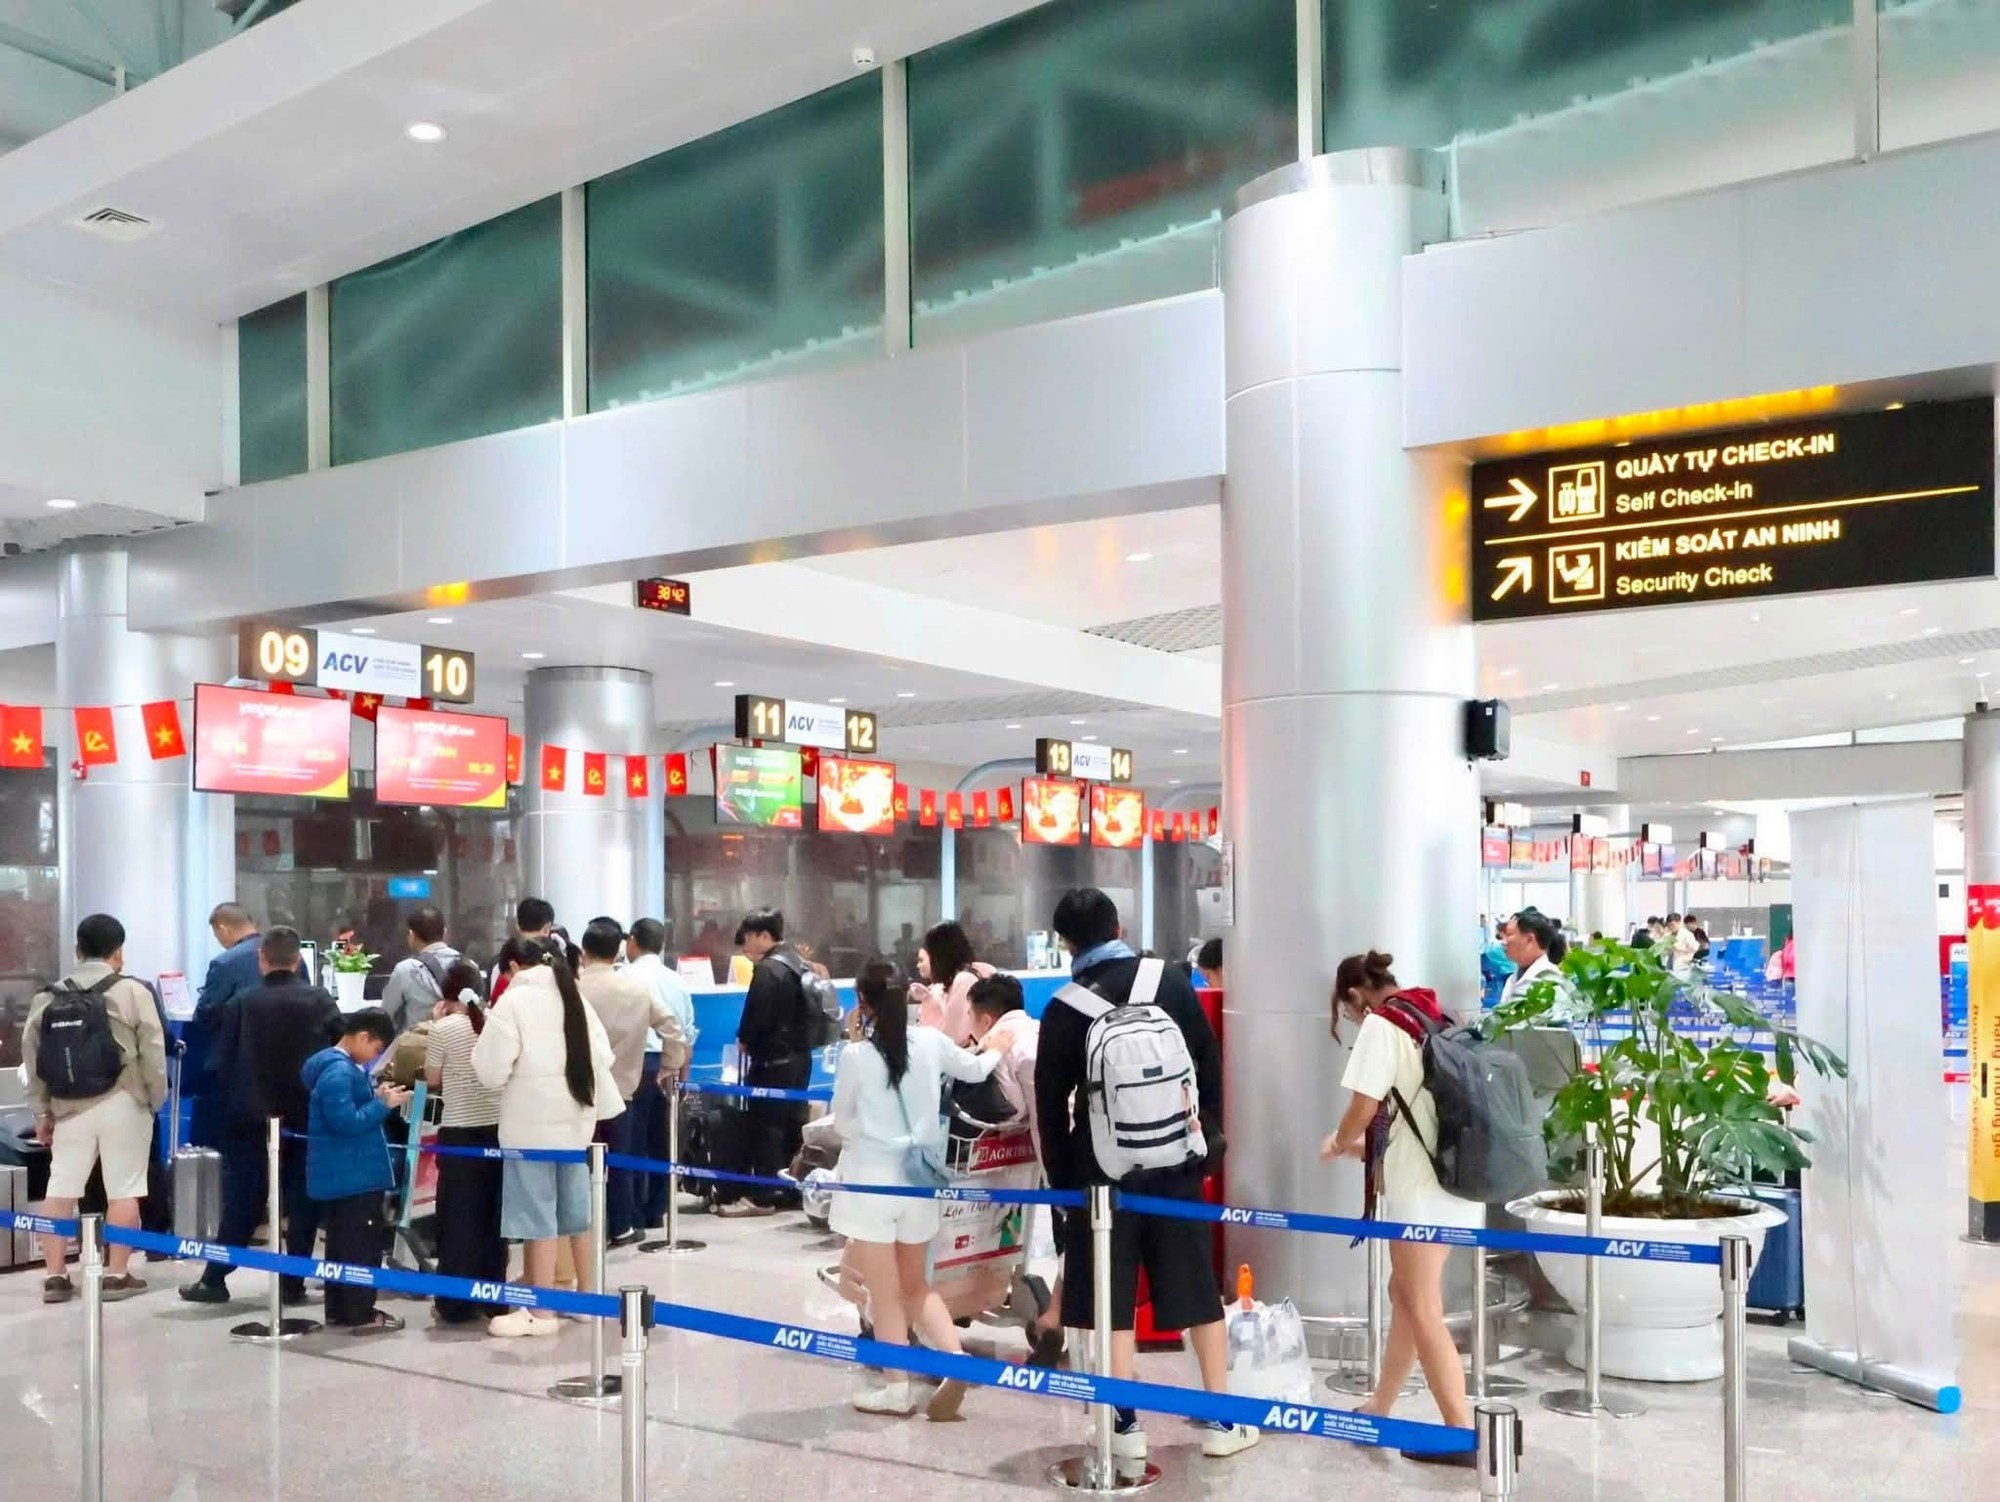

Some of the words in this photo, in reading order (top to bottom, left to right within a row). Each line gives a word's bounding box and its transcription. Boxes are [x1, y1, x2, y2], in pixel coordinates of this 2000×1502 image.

[1722, 433, 1835, 465] CHECK-IN
[1615, 491, 1655, 514] Self
[1660, 481, 1753, 508] Check-in
[1675, 528, 1738, 555] SOÁT
[1742, 525, 1776, 548] AN
[1783, 519, 1840, 544] NINH
[1616, 571, 1699, 595] Security
[1704, 563, 1773, 587] Check
[260, 631, 309, 677] 09
[323, 652, 368, 674] ACV
[426, 654, 468, 697] 10
[753, 701, 781, 736] 11
[788, 715, 815, 731] ACV
[848, 714, 874, 748] 12
[1049, 743, 1069, 770] 13
[1112, 752, 1131, 780] 14
[14, 1214, 33, 1231] ACV
[1220, 1207, 1253, 1224] ACV
[1402, 1226, 1437, 1242] ACV
[178, 1239, 204, 1258] ACV
[1605, 1240, 1647, 1257] ACV
[315, 1261, 343, 1279] ACV
[470, 1282, 502, 1301] ACV
[772, 1327, 814, 1351] ACV
[997, 1365, 1046, 1391] ACV
[1263, 1405, 1318, 1432] ACV
